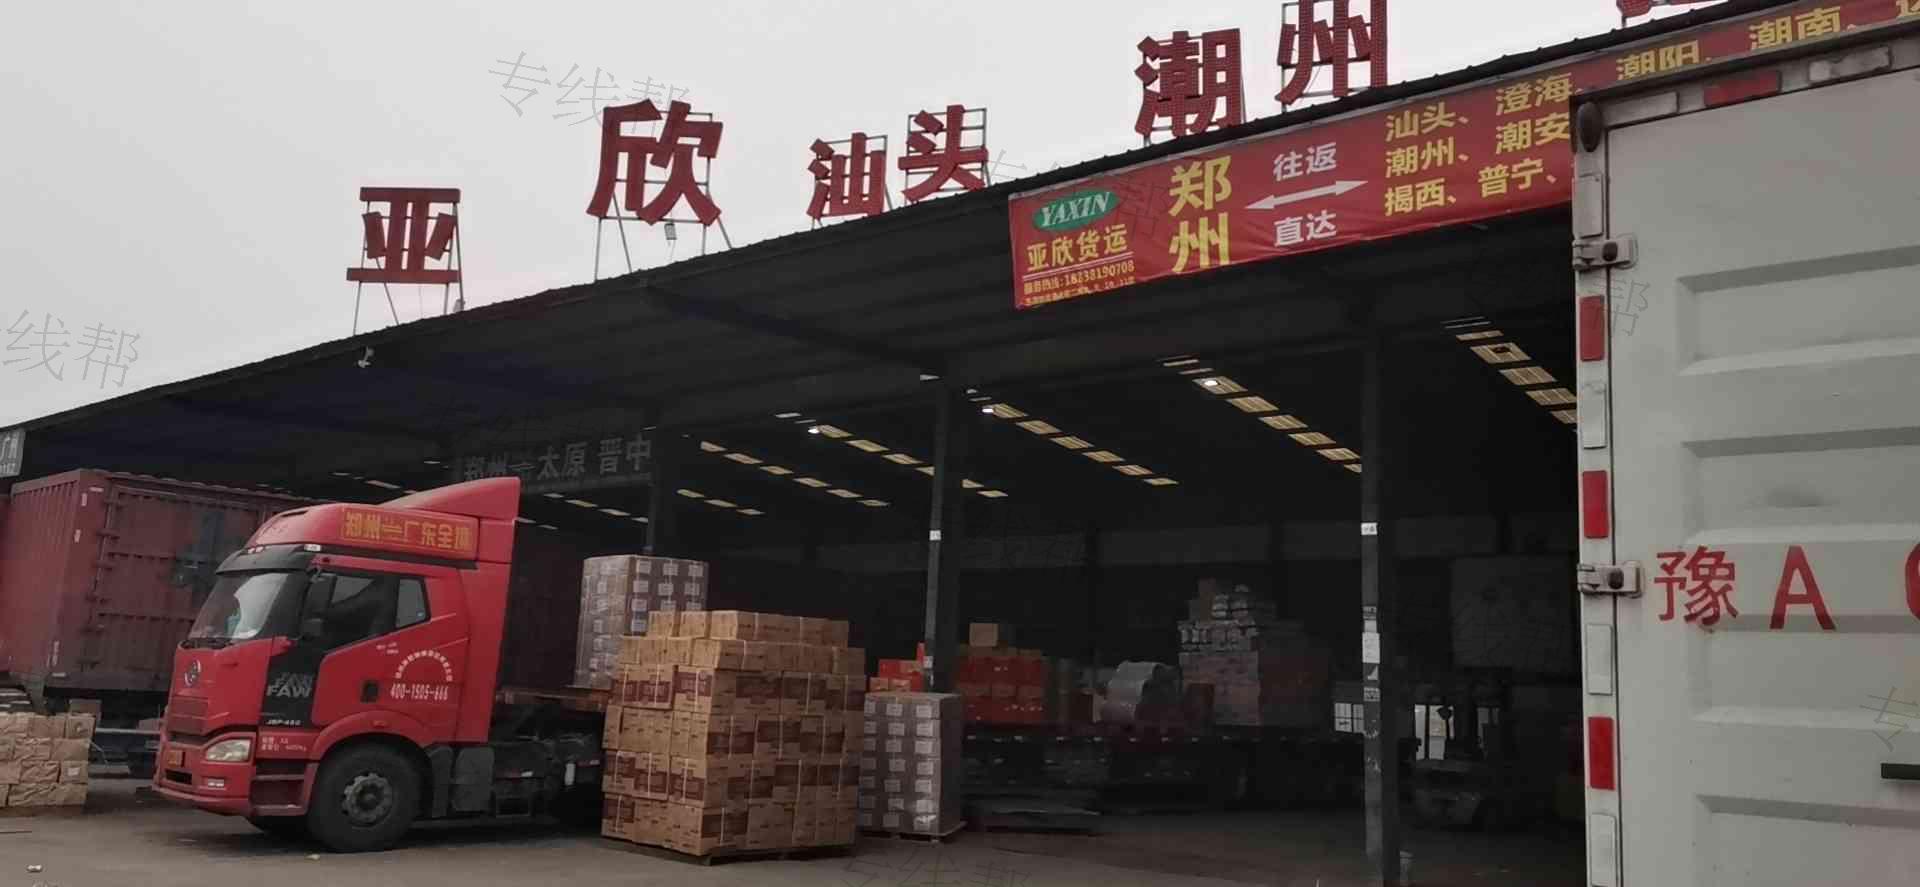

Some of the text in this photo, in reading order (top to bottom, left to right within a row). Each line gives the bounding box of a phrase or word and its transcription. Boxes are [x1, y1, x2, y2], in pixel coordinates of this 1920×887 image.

[1273, 142, 1337, 181] 往返
[1041, 191, 1111, 227] YAXIN
[1168, 155, 1232, 273] 郑州
[1274, 209, 1337, 247] 直达
[1027, 224, 1128, 271] 亚欣货运
[536, 440, 587, 480] 太原
[265, 684, 313, 699] FAW
